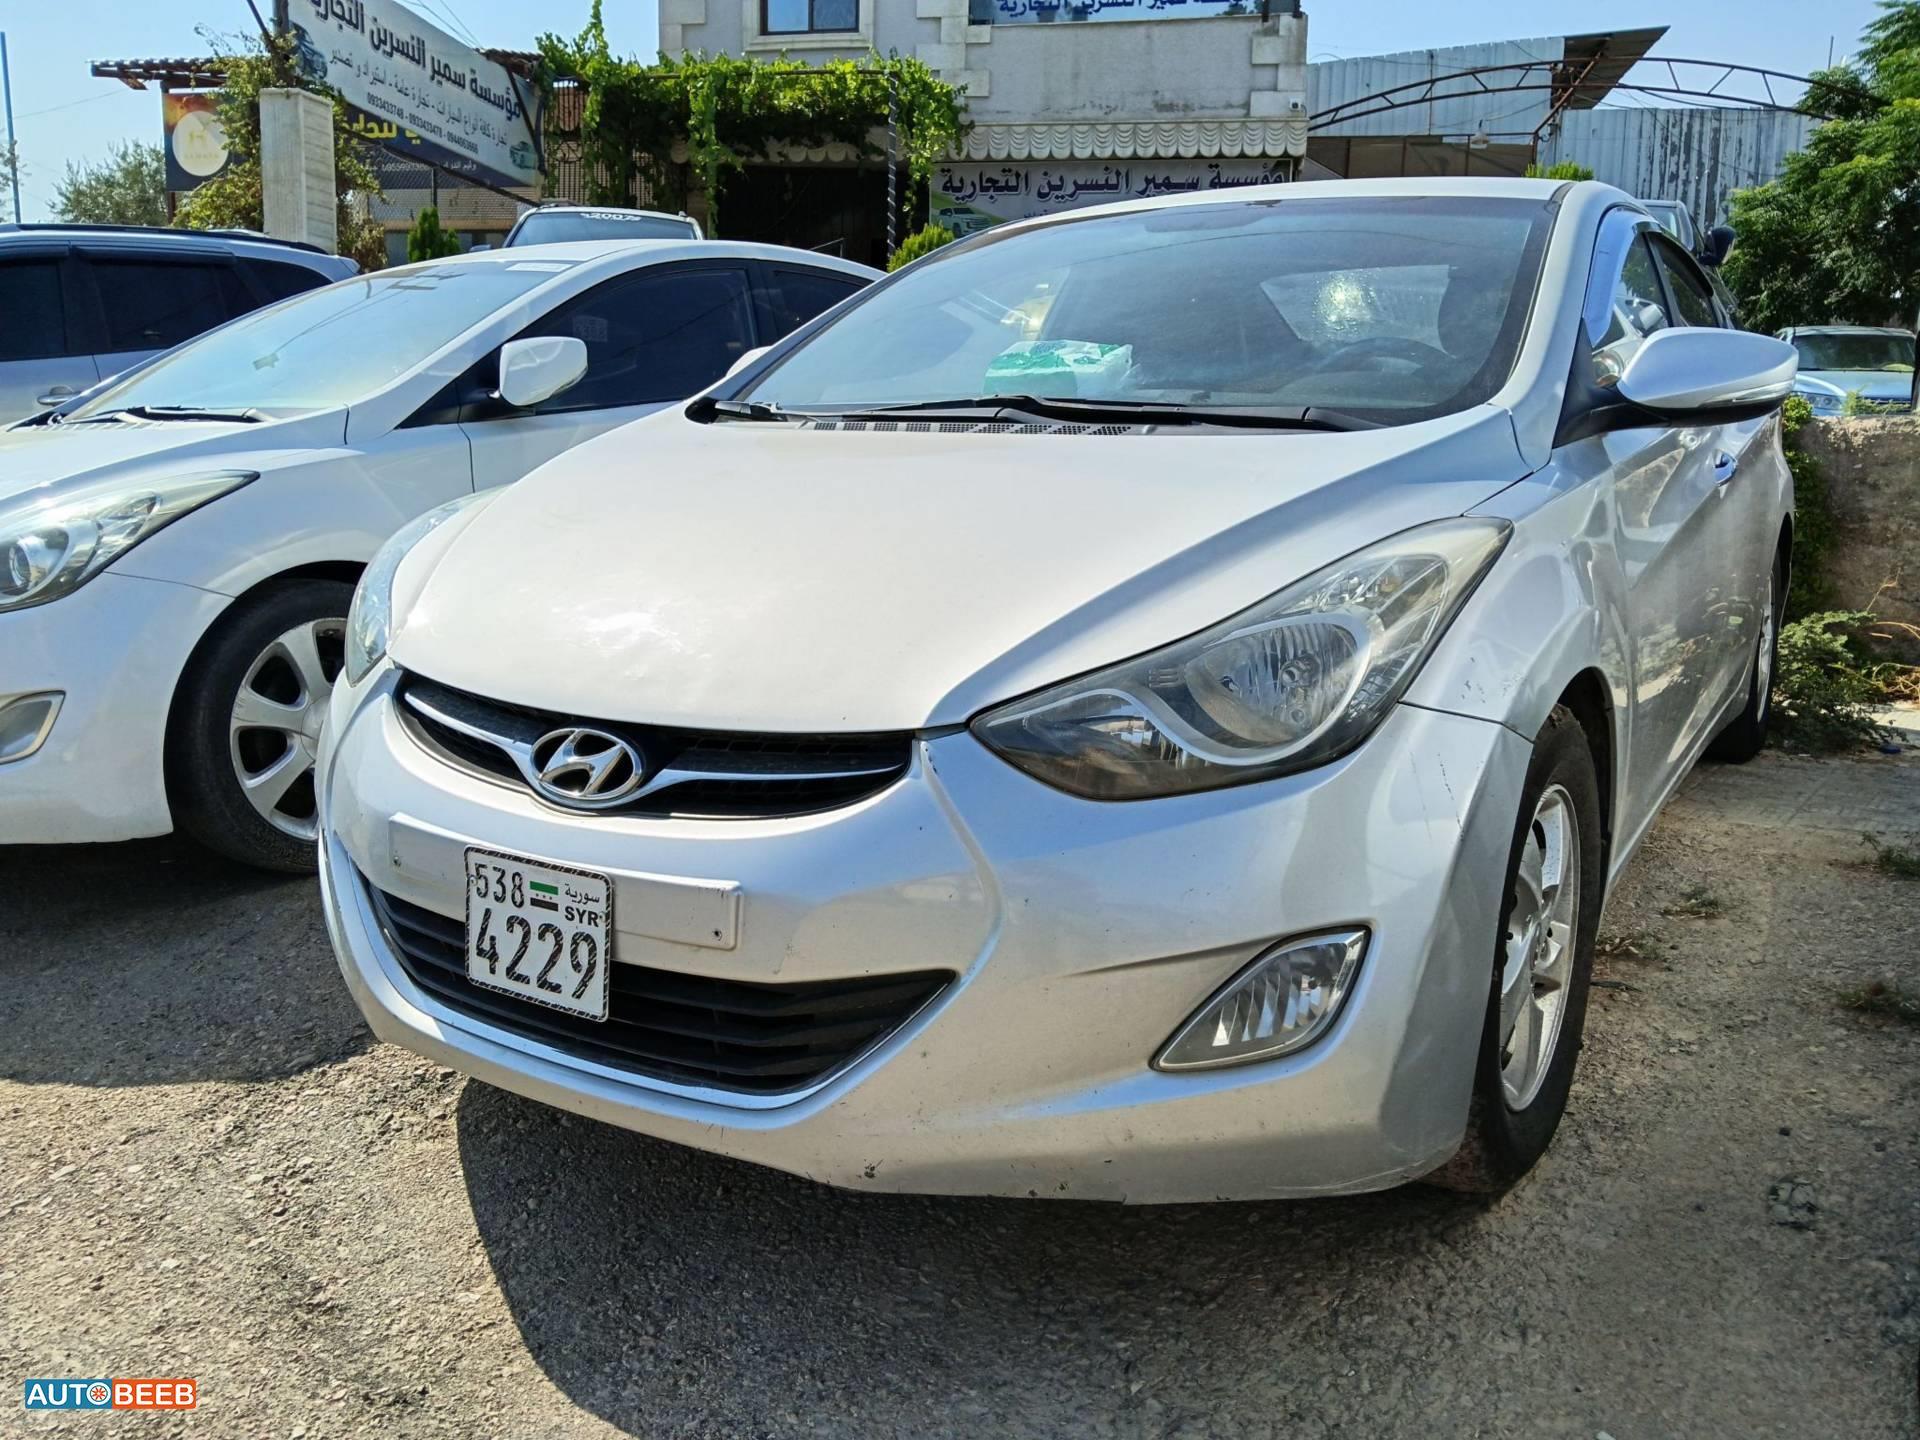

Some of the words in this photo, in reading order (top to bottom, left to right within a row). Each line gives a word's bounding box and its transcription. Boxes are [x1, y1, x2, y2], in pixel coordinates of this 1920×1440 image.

[370, 16, 426, 68] النسرين
[430, 55, 466, 87] سمير
[940, 168, 1029, 201] التجارية
[1037, 165, 1131, 199] النسرين
[1136, 173, 1200, 197] سمير
[474, 862, 524, 908] 538
[564, 883, 600, 904] سورية
[564, 906, 599, 927] SYR
[476, 908, 598, 1000] 4229
